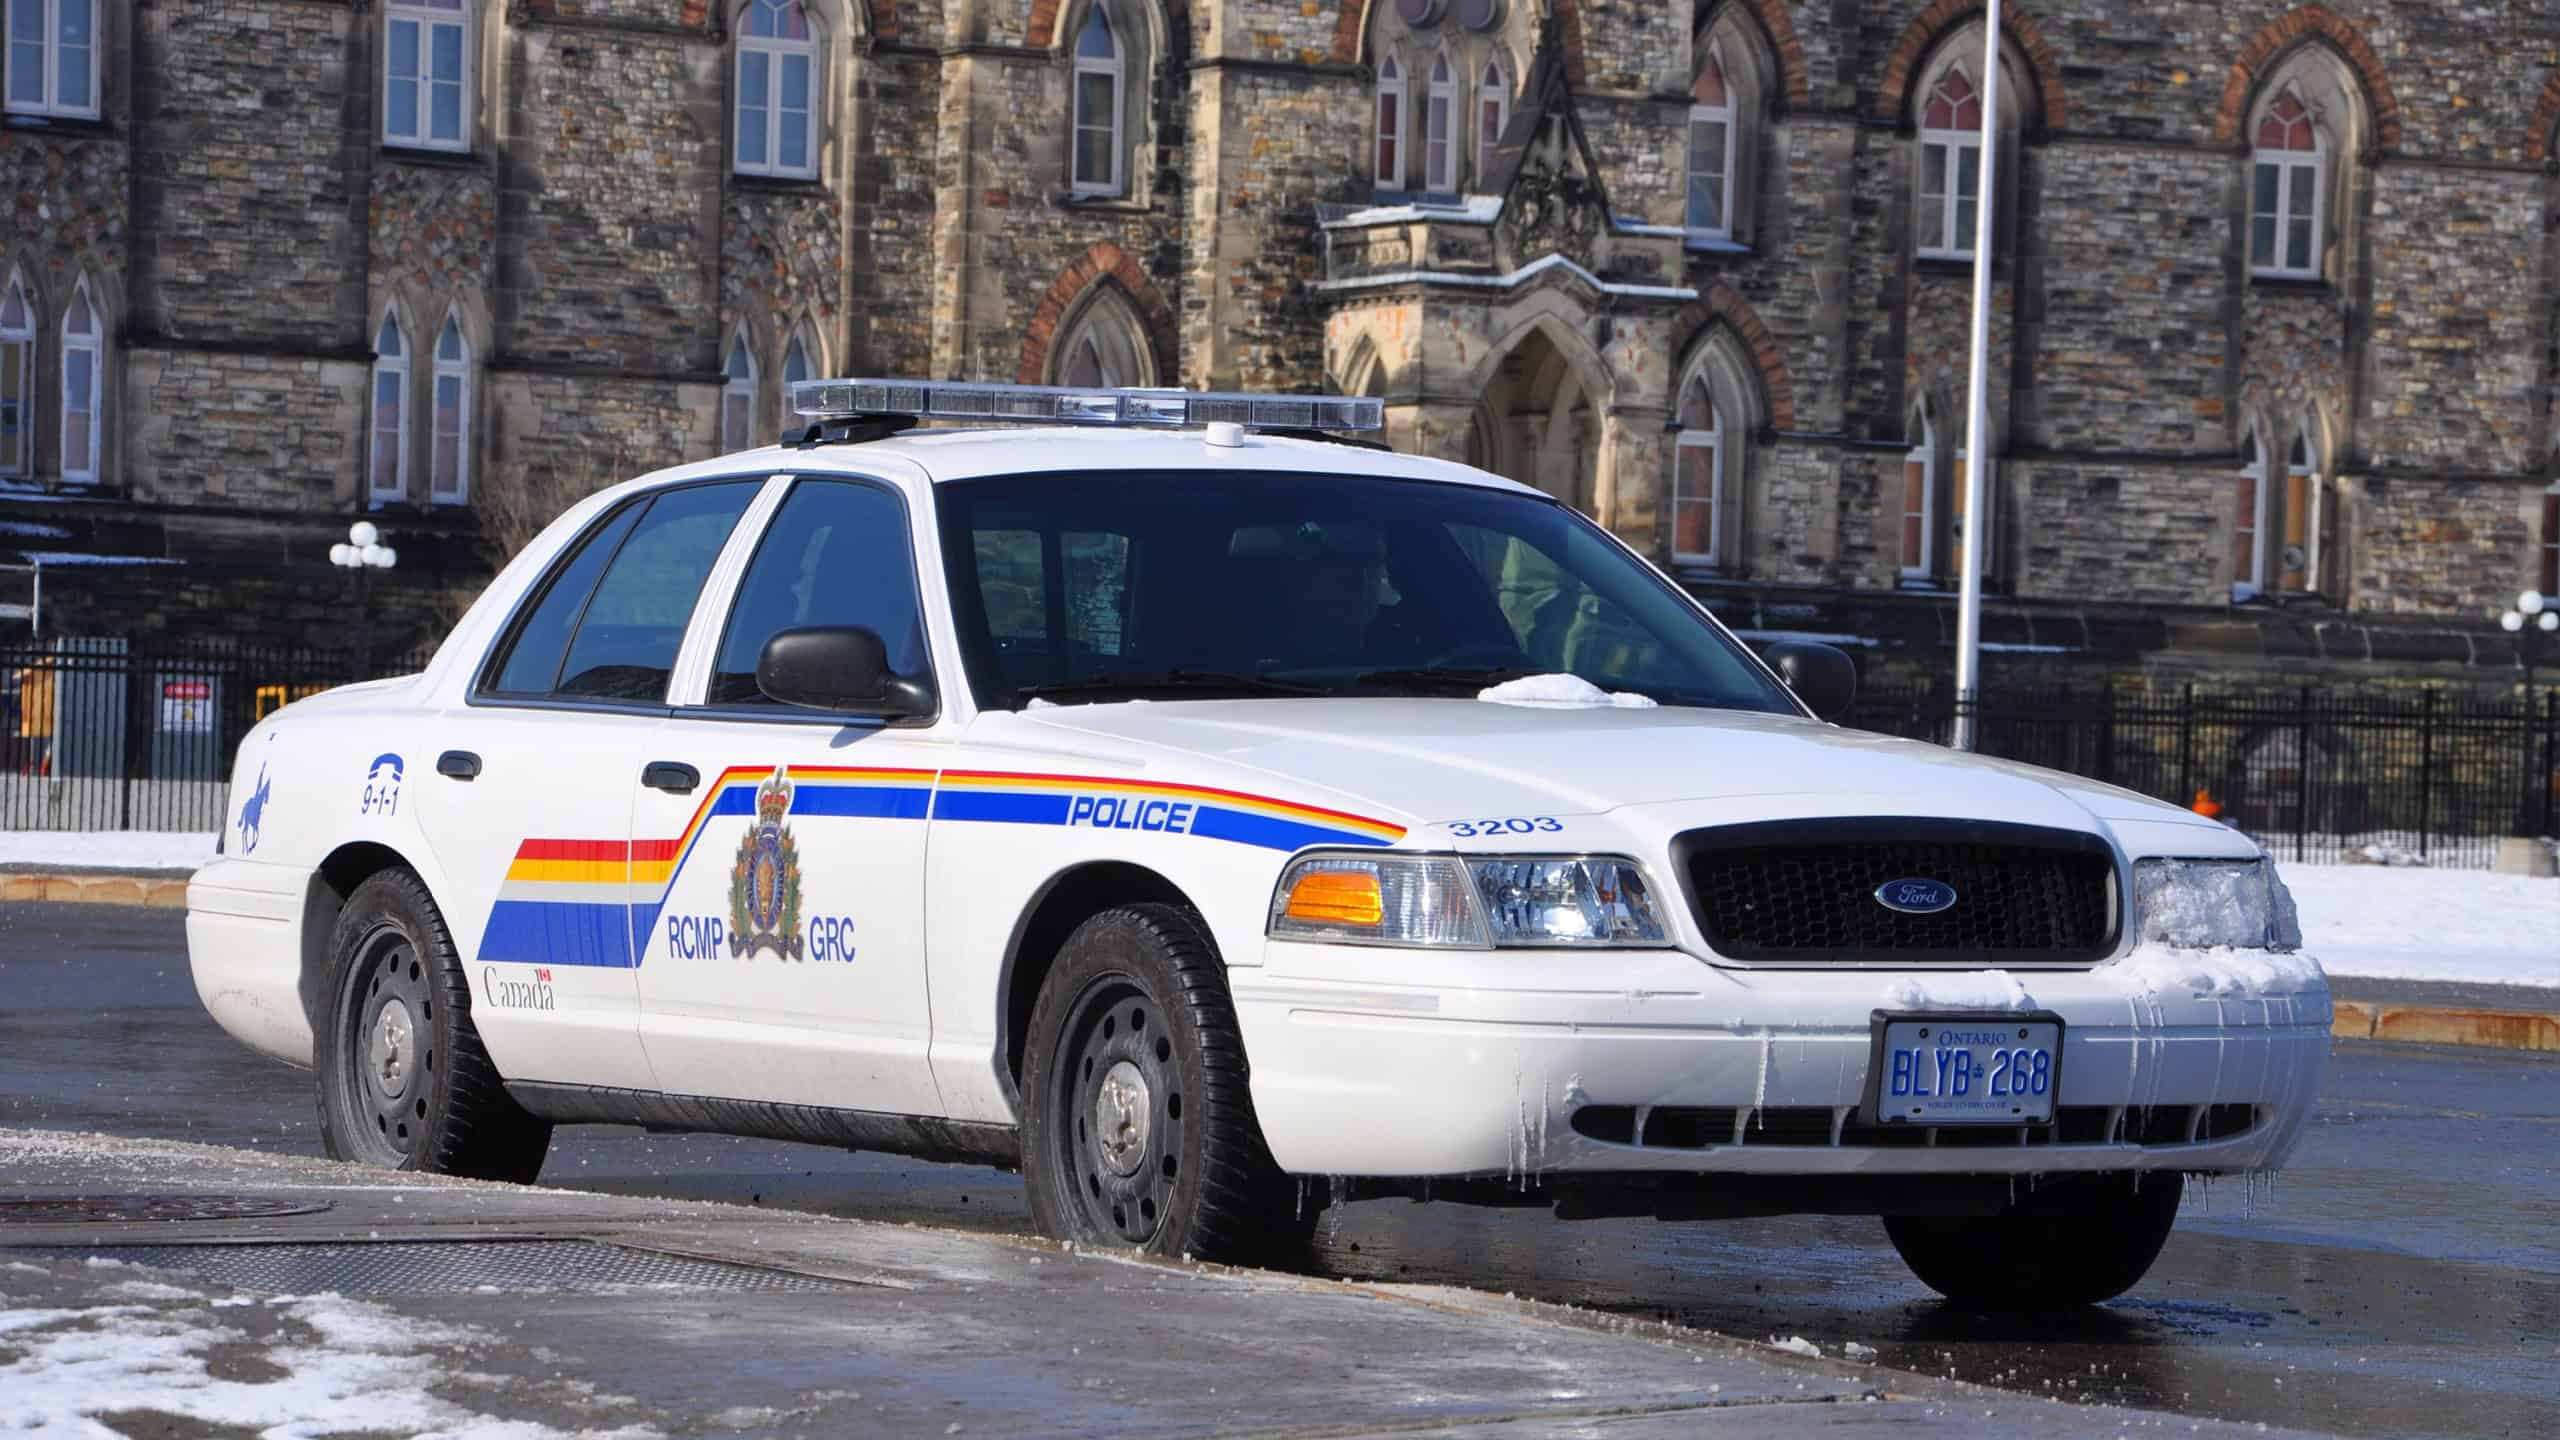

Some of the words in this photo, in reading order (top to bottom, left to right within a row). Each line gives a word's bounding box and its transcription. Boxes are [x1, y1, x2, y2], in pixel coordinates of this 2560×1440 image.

[361, 784, 400, 816] 9-1-1
[1070, 796, 1192, 834] POLICE
[1448, 817, 1563, 837] 3203
[1898, 884, 1937, 904] Ford
[668, 915, 723, 960] RCMP
[810, 916, 856, 963] GRC
[484, 966, 555, 1010] Canada
[1939, 1031, 2007, 1046] ONTARIO
[1891, 1048, 1971, 1097] BLYB
[1989, 1048, 2049, 1097] 268
